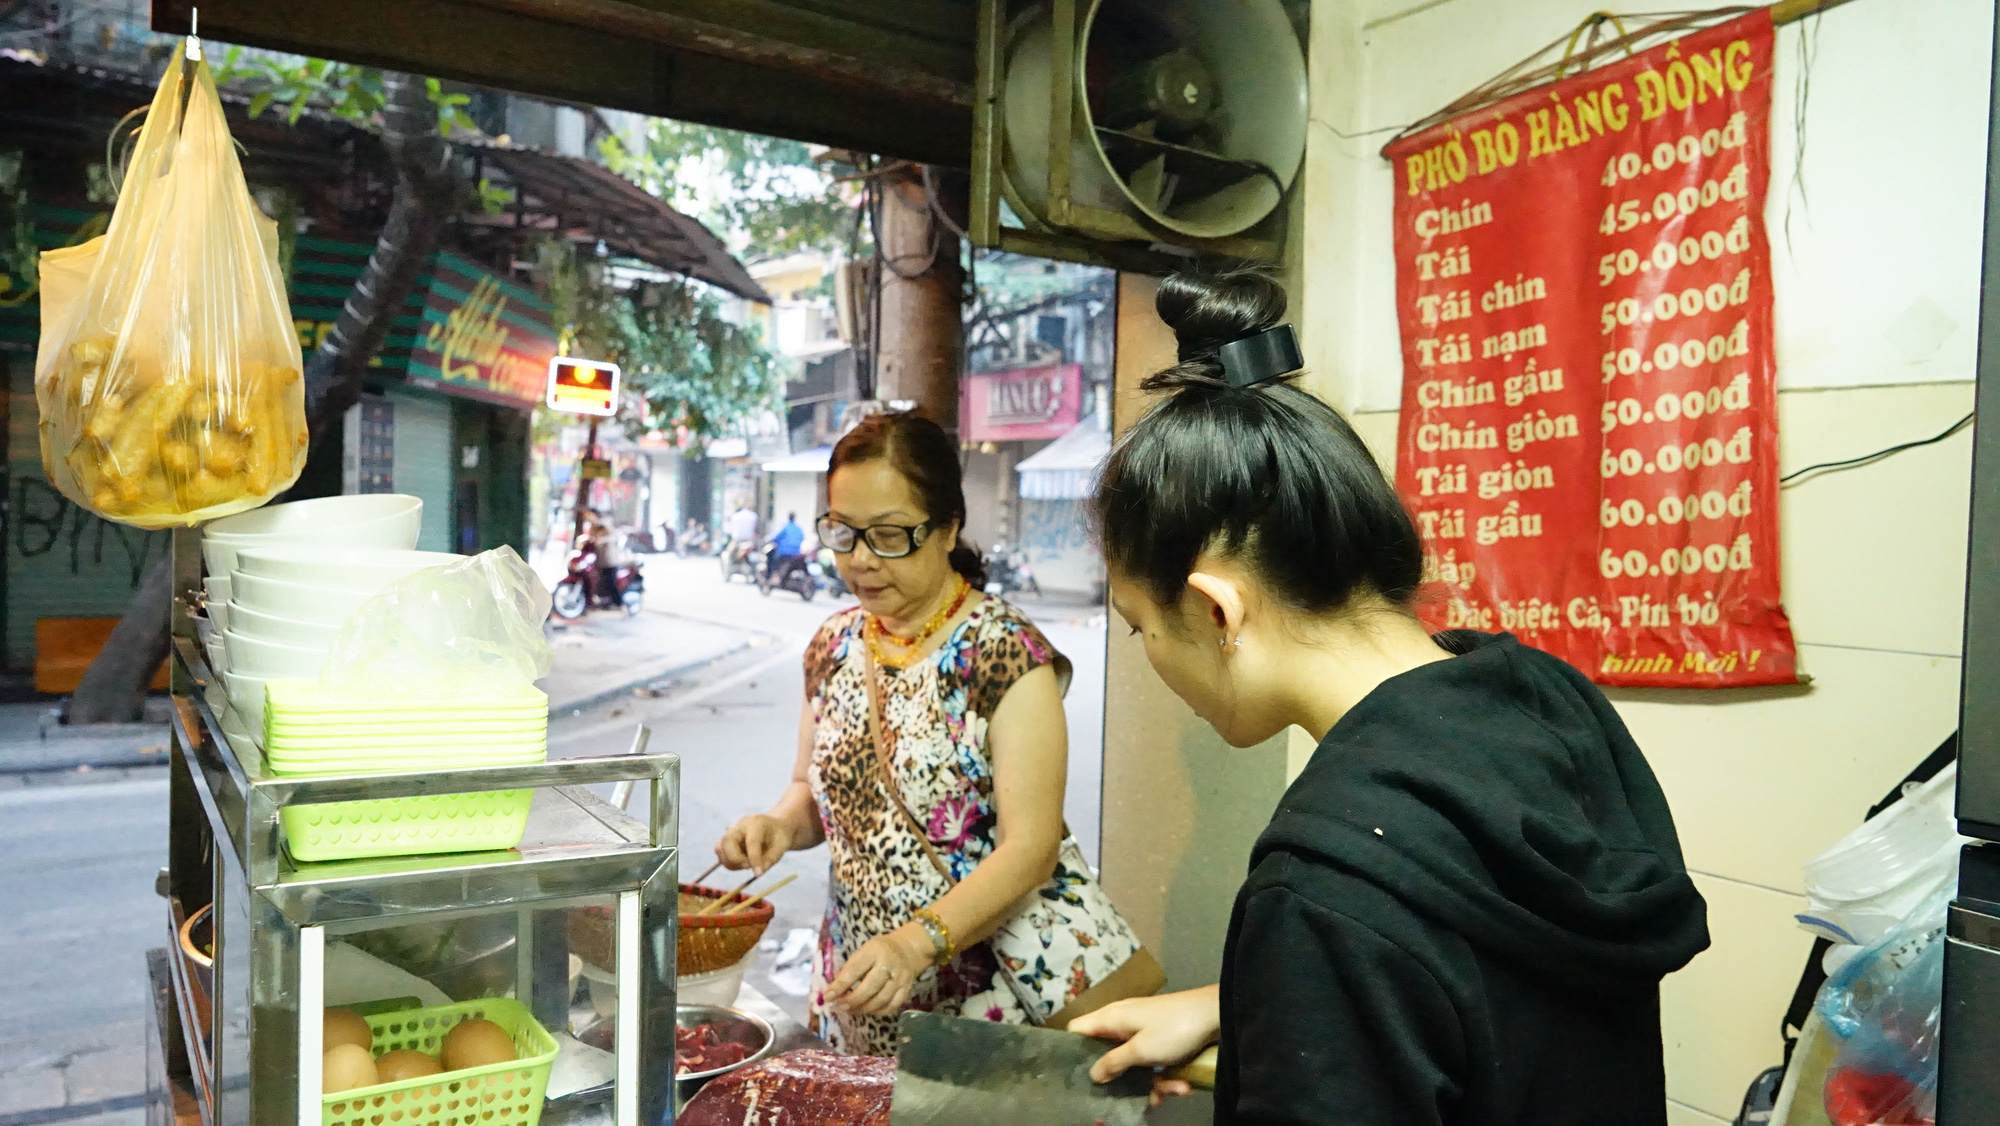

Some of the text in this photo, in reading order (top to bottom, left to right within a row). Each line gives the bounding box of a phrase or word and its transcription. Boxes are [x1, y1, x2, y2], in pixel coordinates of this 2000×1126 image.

[1406, 123, 1467, 196] PHỞ
[1525, 83, 1629, 158] HÀNG
[1634, 39, 1753, 121] ĐỒNG
[1415, 111, 1747, 238] Chín 40.000đ
[1415, 162, 1749, 281] Tái 45.000đ
[1416, 215, 1751, 325] Tái chín 50.000đ
[1416, 267, 1751, 367] Tái nạm 50.000đ
[1417, 376, 1496, 409] Chín
[1601, 318, 1750, 384] 50.000đ
[1416, 371, 1751, 452] Chín giòn 50.000đ
[1415, 426, 1753, 499] Tái giòn 60.000đ
[1417, 508, 1466, 540] Tái
[1600, 479, 1753, 528] 60.000đ
[1600, 532, 1752, 578] 60.000đ
[1618, 592, 1670, 628] Pín
[1677, 590, 1719, 626] bò
